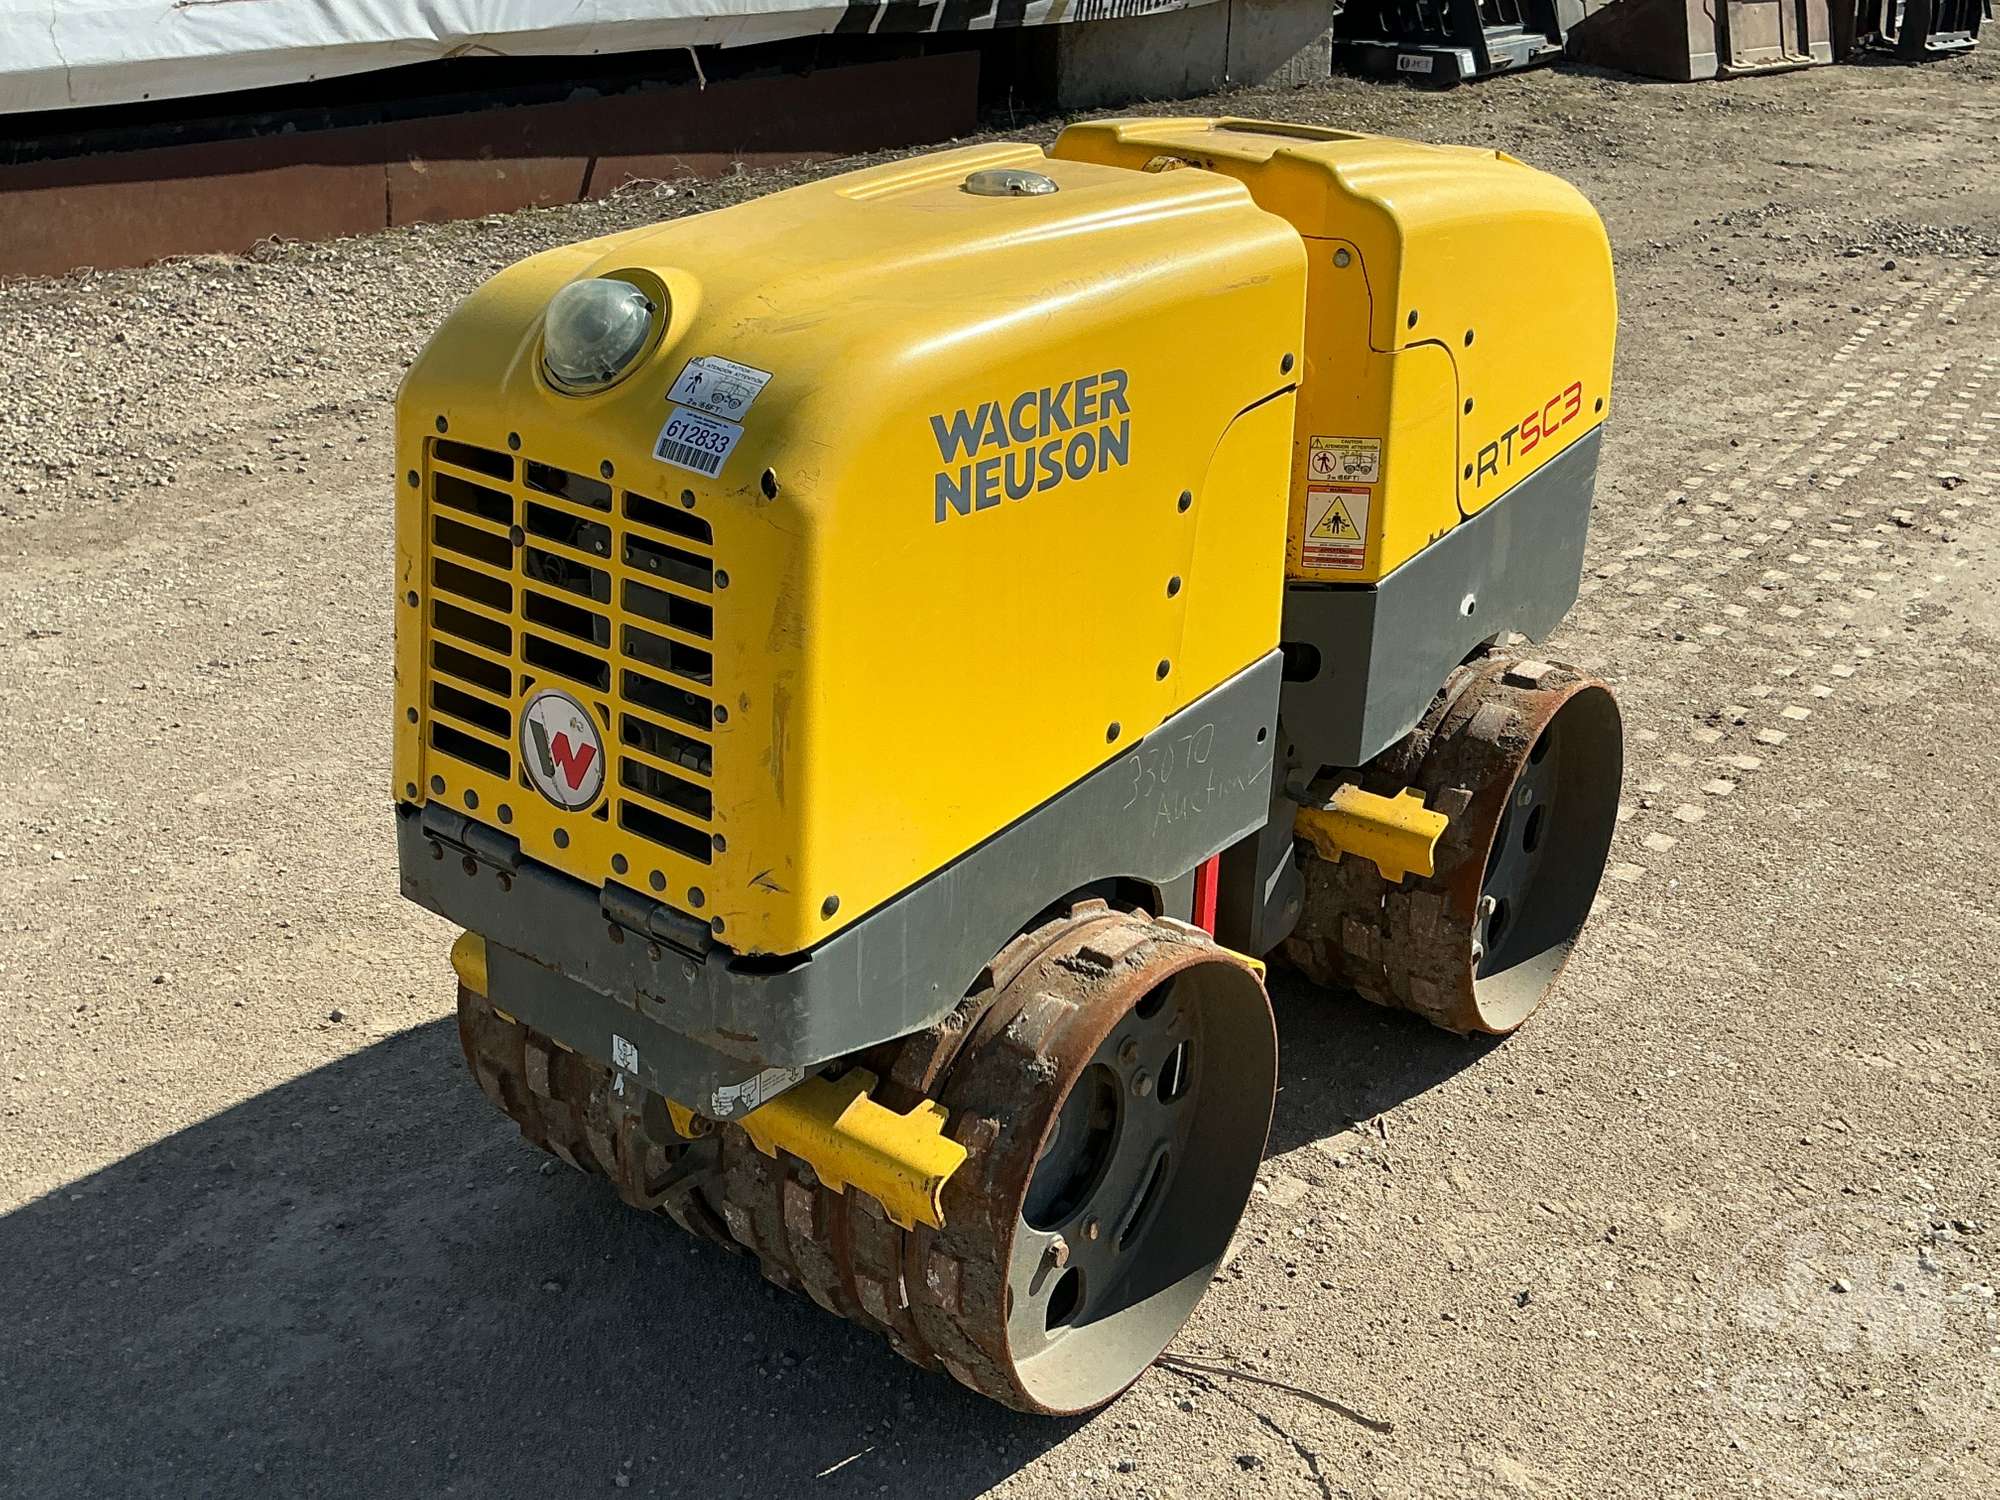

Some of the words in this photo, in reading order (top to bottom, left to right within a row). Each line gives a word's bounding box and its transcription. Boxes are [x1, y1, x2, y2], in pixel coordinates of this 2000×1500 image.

[666, 419, 731, 454] 612833
[930, 368, 1131, 464] WACKER
[934, 418, 1130, 524] NEUSON
